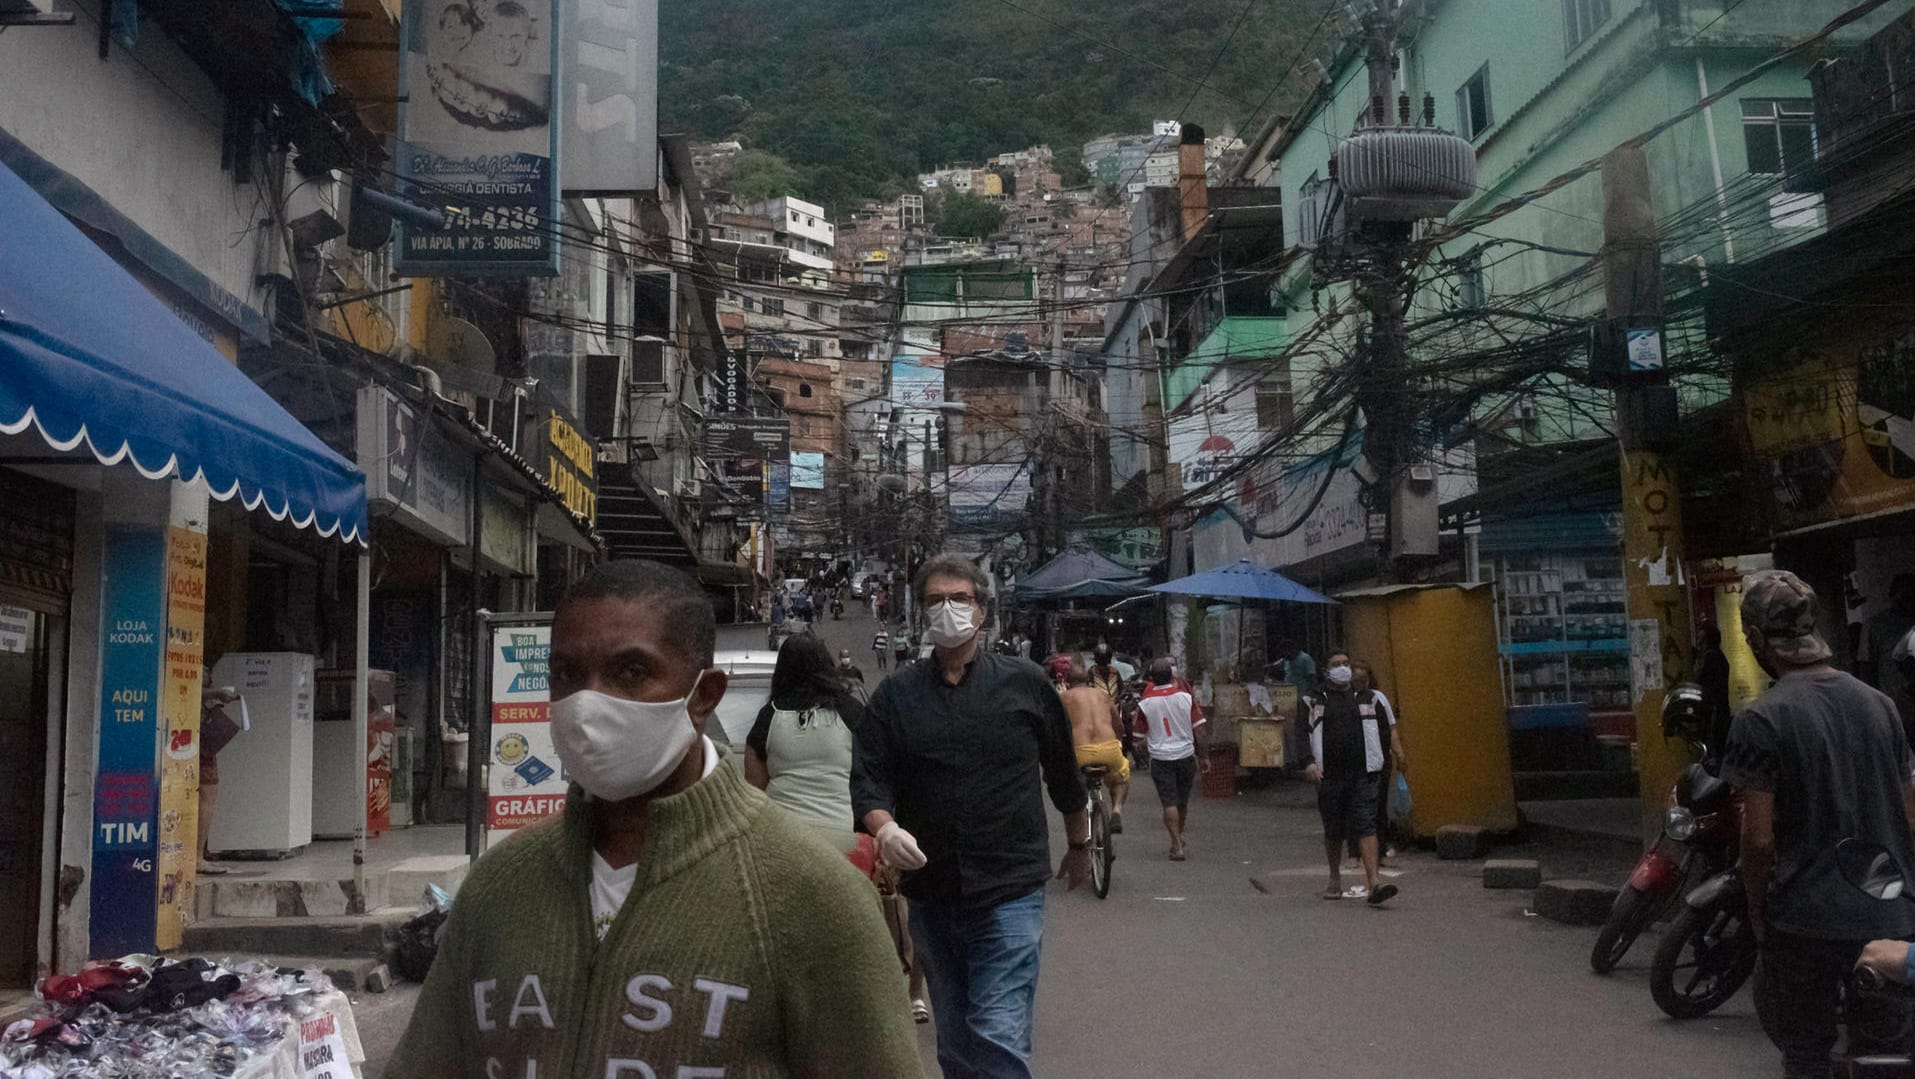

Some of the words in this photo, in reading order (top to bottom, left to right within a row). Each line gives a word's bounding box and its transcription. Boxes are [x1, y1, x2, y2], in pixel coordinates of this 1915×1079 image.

[475, 183, 532, 194] DENTISTA
[411, 237, 426, 249] VIA
[472, 237, 484, 249] 26
[493, 236, 541, 250] SOBRADO
[171, 571, 204, 599] Kodak
[116, 620, 147, 631] LOJA
[109, 633, 153, 644] KODAK
[517, 636, 534, 647] BOA
[112, 690, 148, 705] AQUI
[115, 709, 145, 723] TEM
[499, 708, 541, 720] SERV.
[101, 822, 148, 845] TIM
[132, 857, 152, 872] 4G
